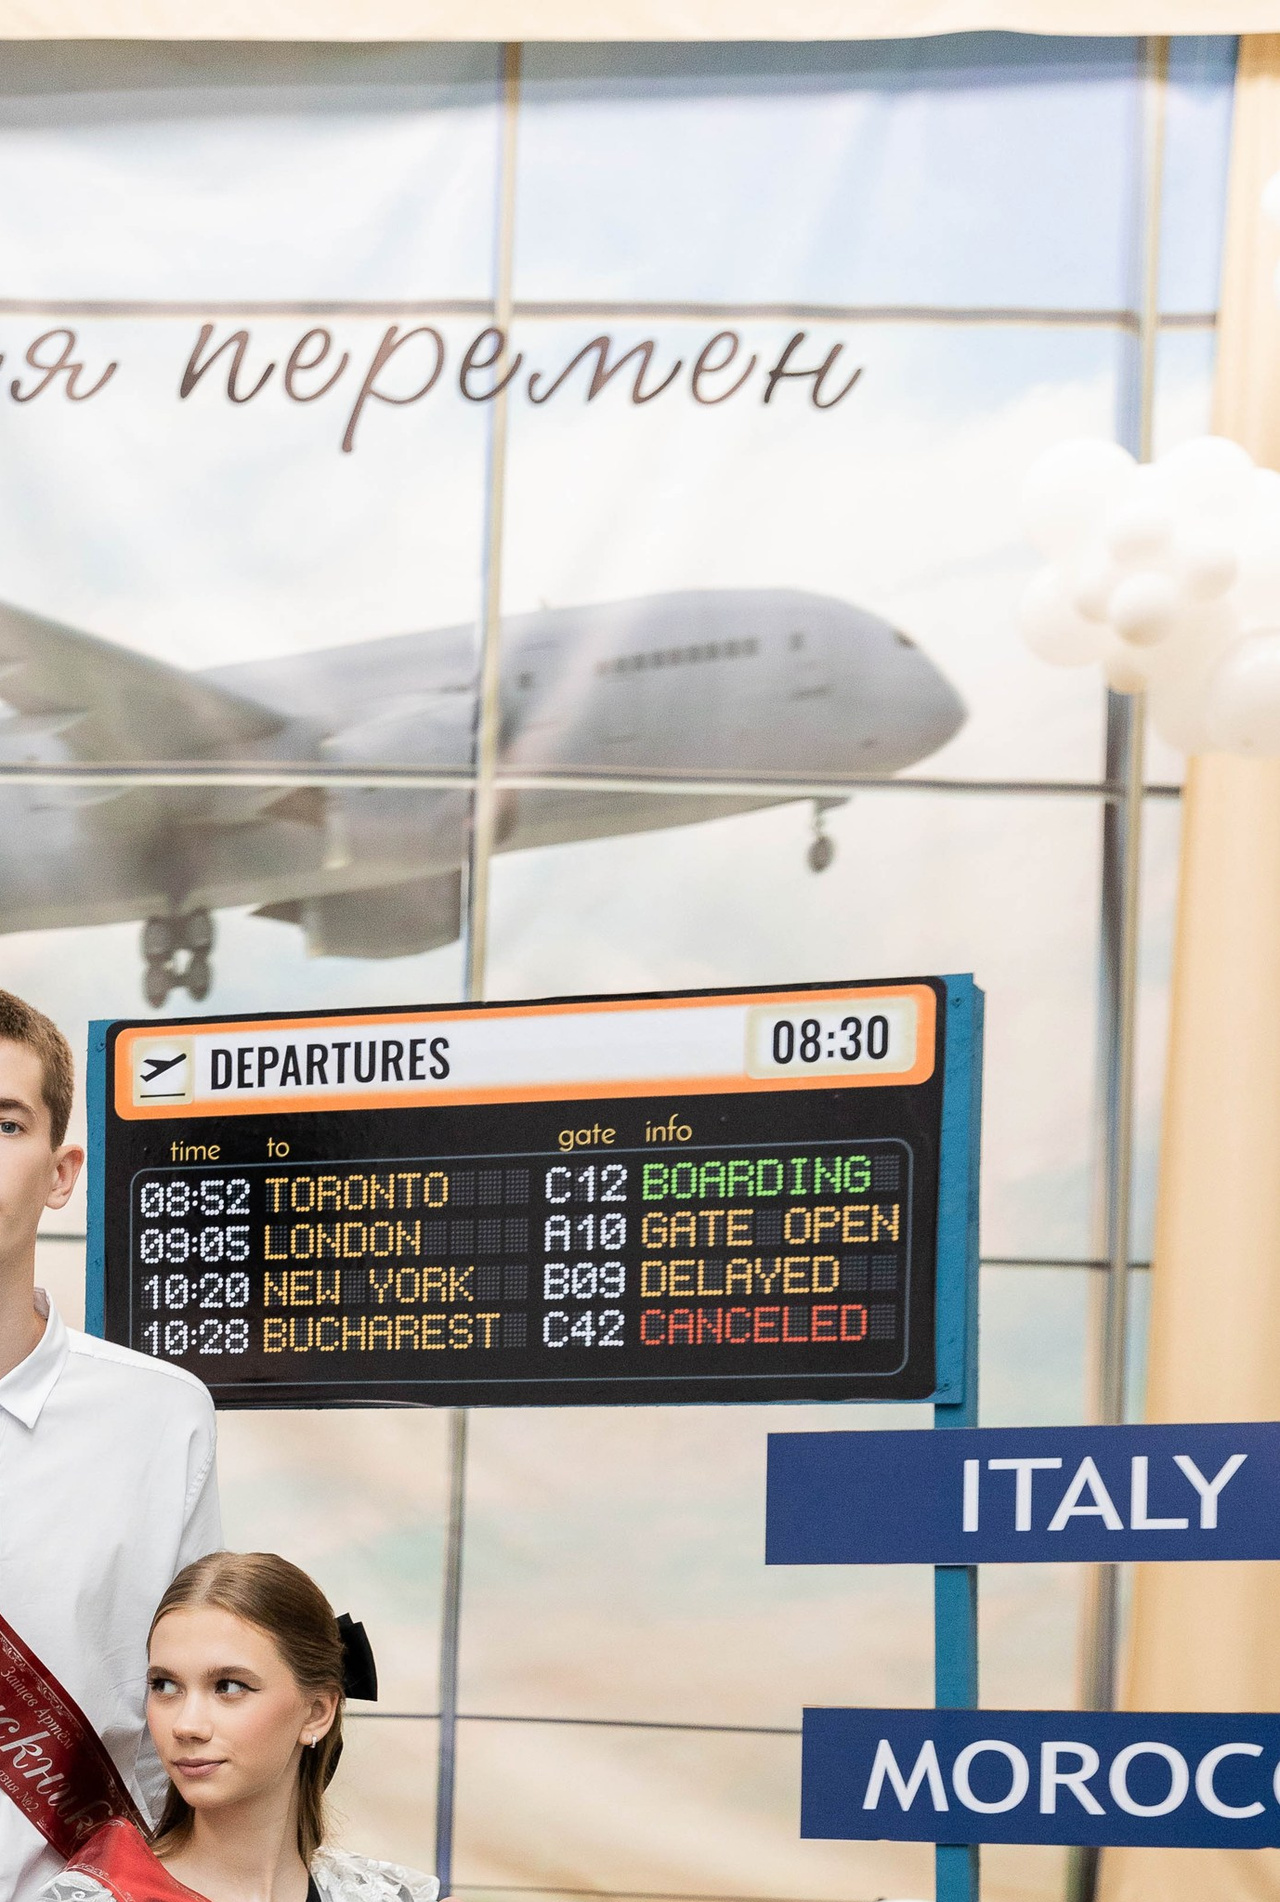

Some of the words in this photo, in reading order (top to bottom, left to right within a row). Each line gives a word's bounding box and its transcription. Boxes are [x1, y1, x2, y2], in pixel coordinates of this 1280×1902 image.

[179, 322, 864, 454] перемен
[211, 1037, 450, 1090] DEPARTURES
[773, 1015, 889, 1065] 08:30
[170, 1141, 221, 1162] time
[267, 1137, 290, 1157] to
[558, 1123, 616, 1152] gate
[646, 1113, 693, 1142] info
[140, 1178, 251, 1218] 08:52
[265, 1171, 449, 1213] TORONTO
[545, 1164, 628, 1204] C12
[642, 1155, 872, 1201] BOARDING
[140, 1225, 250, 1264] 09:05
[264, 1220, 421, 1260] LONDON
[544, 1212, 627, 1252] A10
[641, 1208, 754, 1249] GATE
[784, 1203, 900, 1245] OPEN
[144, 1272, 250, 1310] 10:20
[263, 1269, 341, 1307] NEW
[369, 1265, 475, 1304] YORK
[543, 1261, 626, 1300] B09
[640, 1255, 840, 1298] DELAYED
[143, 1318, 249, 1356] 10:28
[263, 1312, 501, 1353] BUCHAREST
[542, 1309, 625, 1348] C42
[640, 1304, 868, 1346] CANCELED
[962, 1453, 1248, 1533] ITALY
[0, 1666, 38, 1708] Зайцев
[34, 1708, 75, 1750] Артём
[16, 1791, 40, 1813] №2
[862, 1739, 1280, 1819] MOROC
